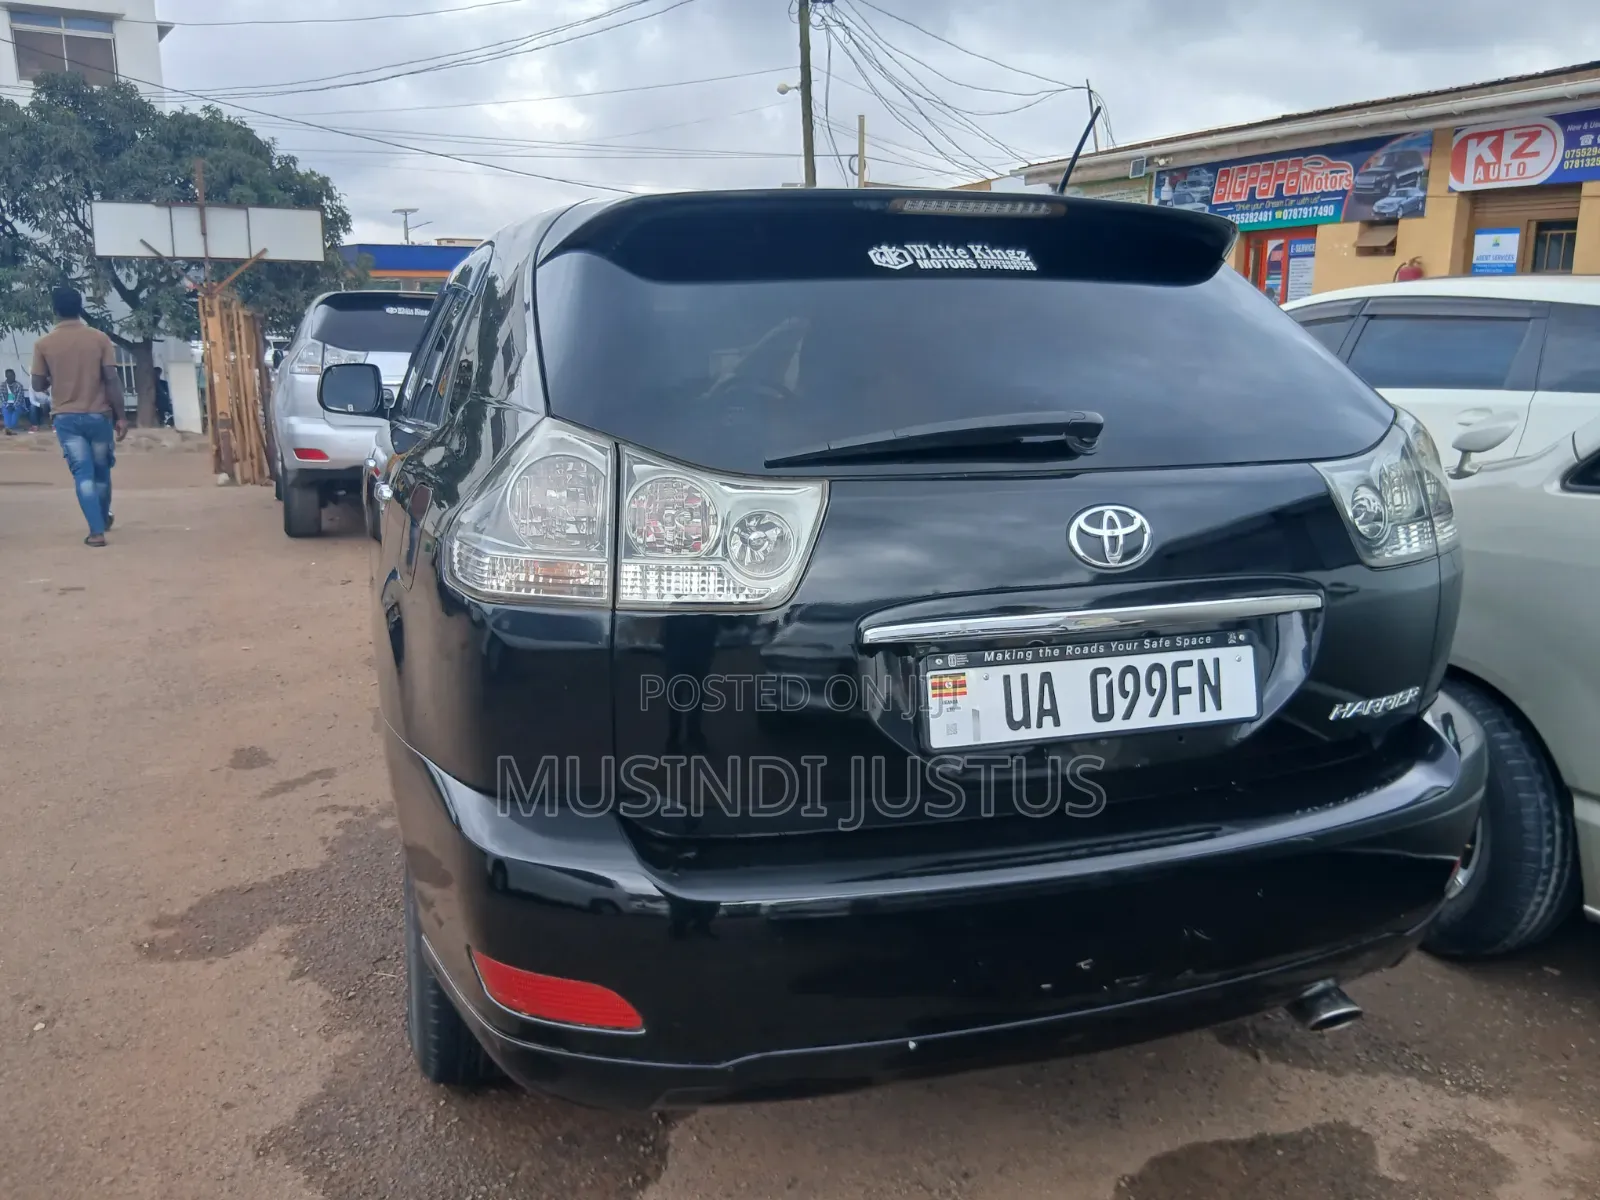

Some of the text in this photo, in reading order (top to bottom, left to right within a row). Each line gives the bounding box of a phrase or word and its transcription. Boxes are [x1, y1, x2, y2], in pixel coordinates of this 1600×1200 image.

[1474, 161, 1527, 181] AUTO
[1301, 171, 1353, 194] Motors
[1282, 205, 1335, 220] 0787917490
[904, 244, 1030, 261] White Kingz
[916, 259, 978, 269] MOTORS
[983, 635, 1212, 662] Making the Roads Your Safe Space
[1002, 656, 1223, 731] UA 099FN
[1328, 686, 1420, 721] HARRIER
